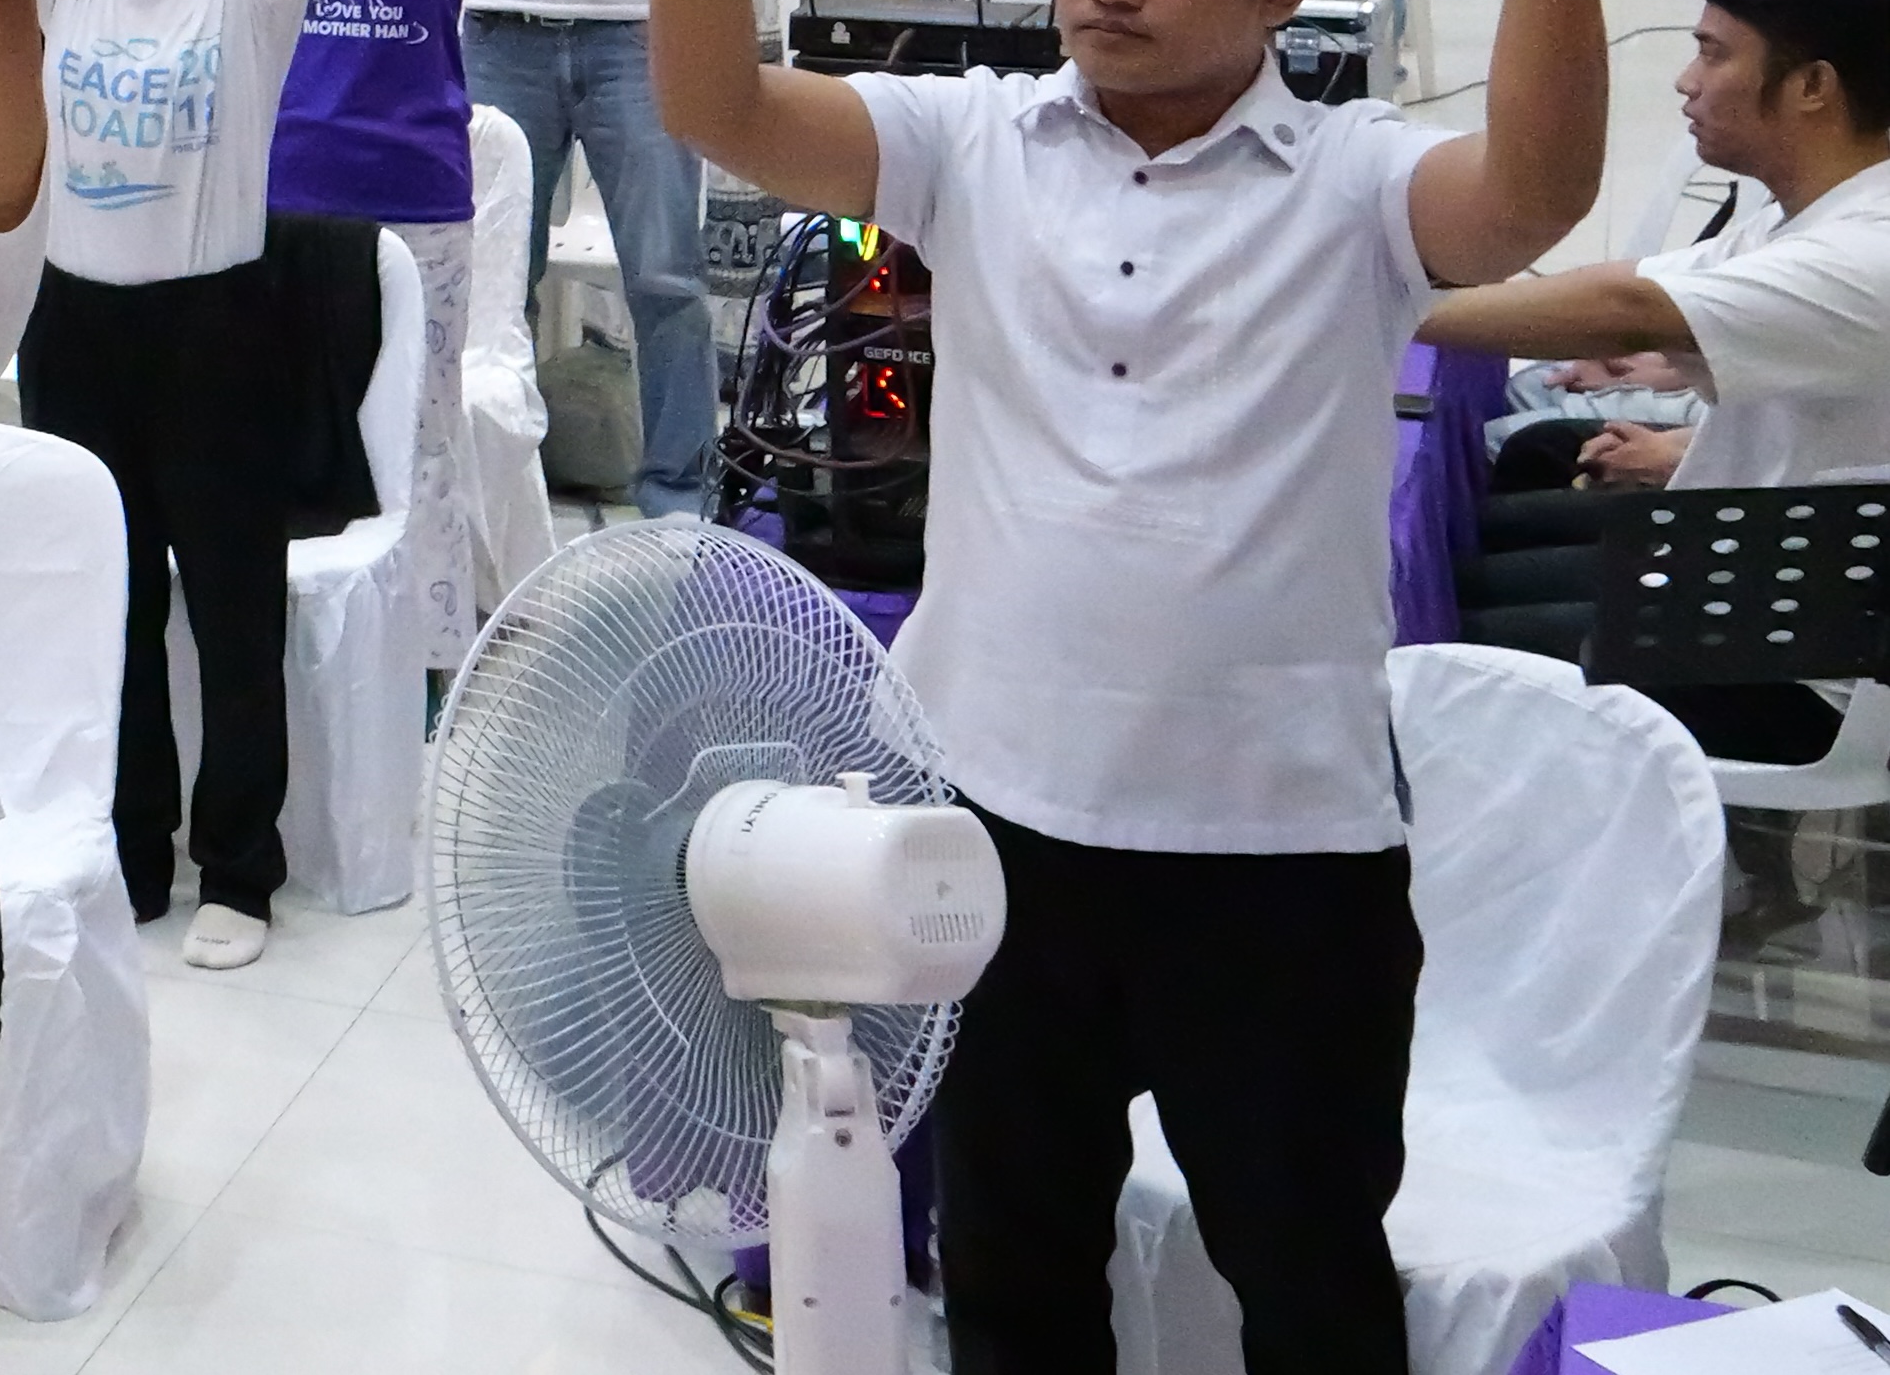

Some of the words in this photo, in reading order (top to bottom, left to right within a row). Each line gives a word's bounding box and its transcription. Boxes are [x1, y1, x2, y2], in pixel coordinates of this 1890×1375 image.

[315, 1, 362, 19] LOVE
[369, 6, 404, 21] YOU
[303, 19, 371, 38] MOTHER
[374, 25, 409, 39] HAN
[58, 48, 170, 105] EACE
[71, 99, 165, 148] OAD
